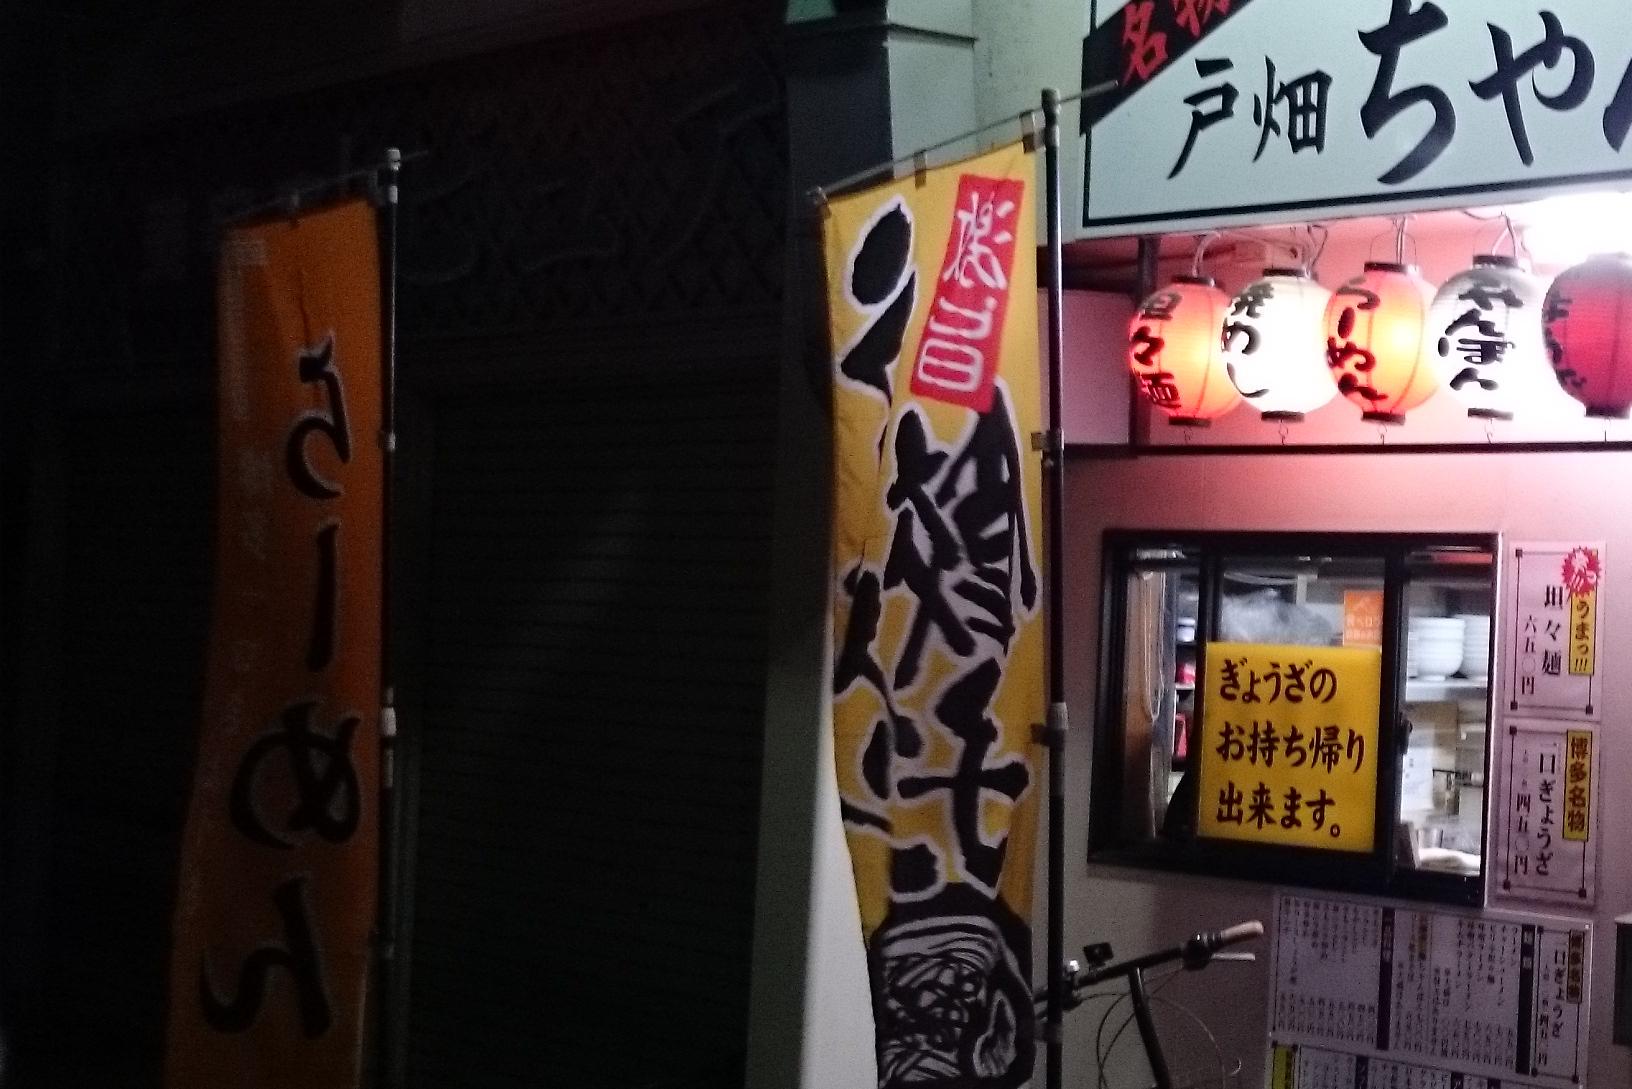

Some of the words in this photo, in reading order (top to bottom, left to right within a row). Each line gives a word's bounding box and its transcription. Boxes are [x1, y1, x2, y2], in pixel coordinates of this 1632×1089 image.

[1168, 56, 1332, 180] 戸畑
[1219, 657, 1338, 705] ぎょうざの
[1216, 719, 1367, 775] お持ち帰り
[1567, 736, 1589, 833] 博多名物
[1216, 780, 1341, 839] 出来ます。
[1536, 741, 1557, 877] 一口ぎょうざ
